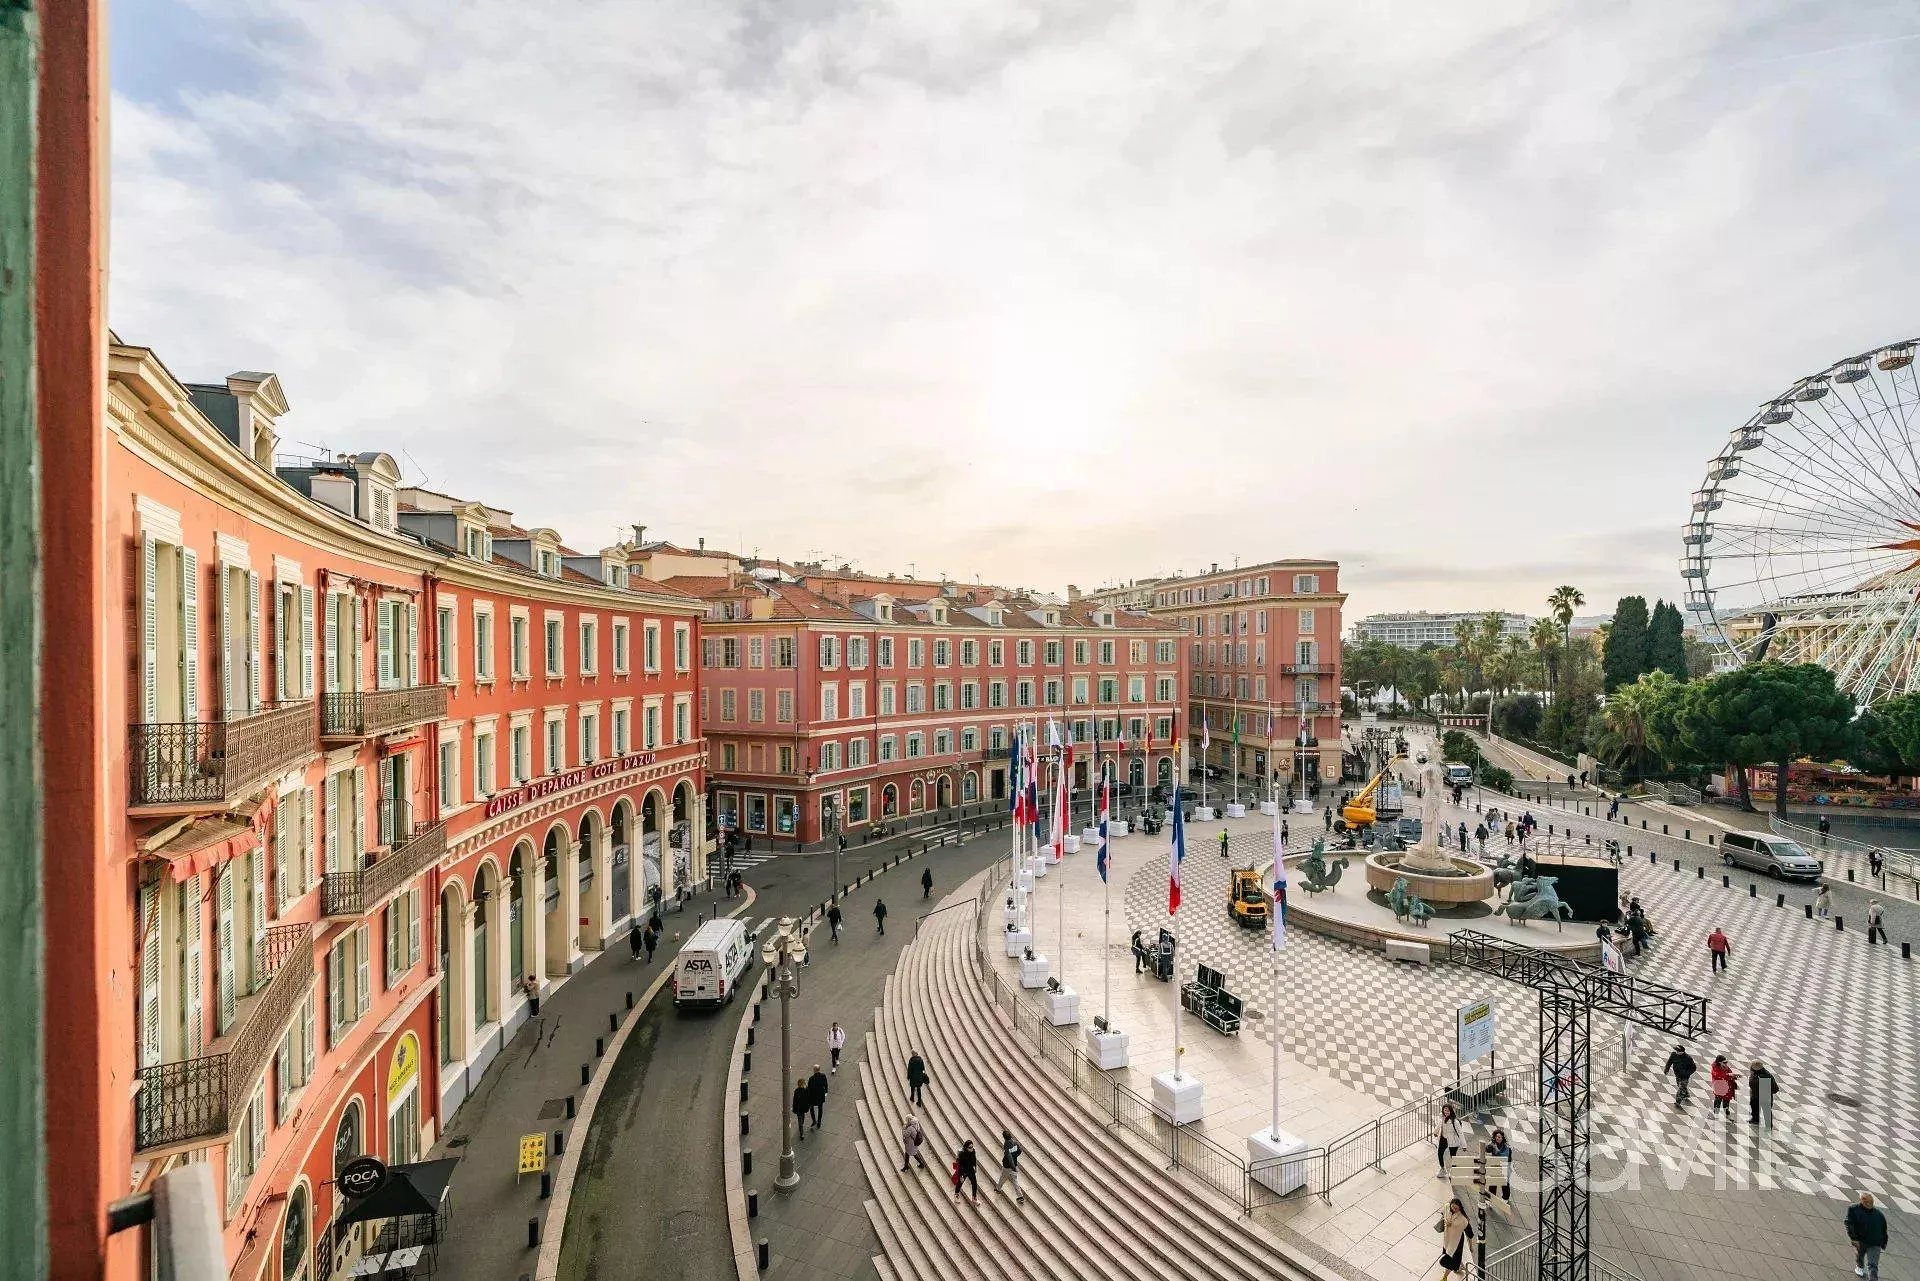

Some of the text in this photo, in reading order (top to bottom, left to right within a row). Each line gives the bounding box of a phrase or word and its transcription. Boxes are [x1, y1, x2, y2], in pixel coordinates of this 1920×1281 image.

[489, 791, 524, 817] CAISSE
[531, 771, 586, 800] D'EPARGNE
[624, 754, 656, 769] D'AZUR
[684, 959, 712, 971] ASTA
[343, 1169, 379, 1184] FOCA
